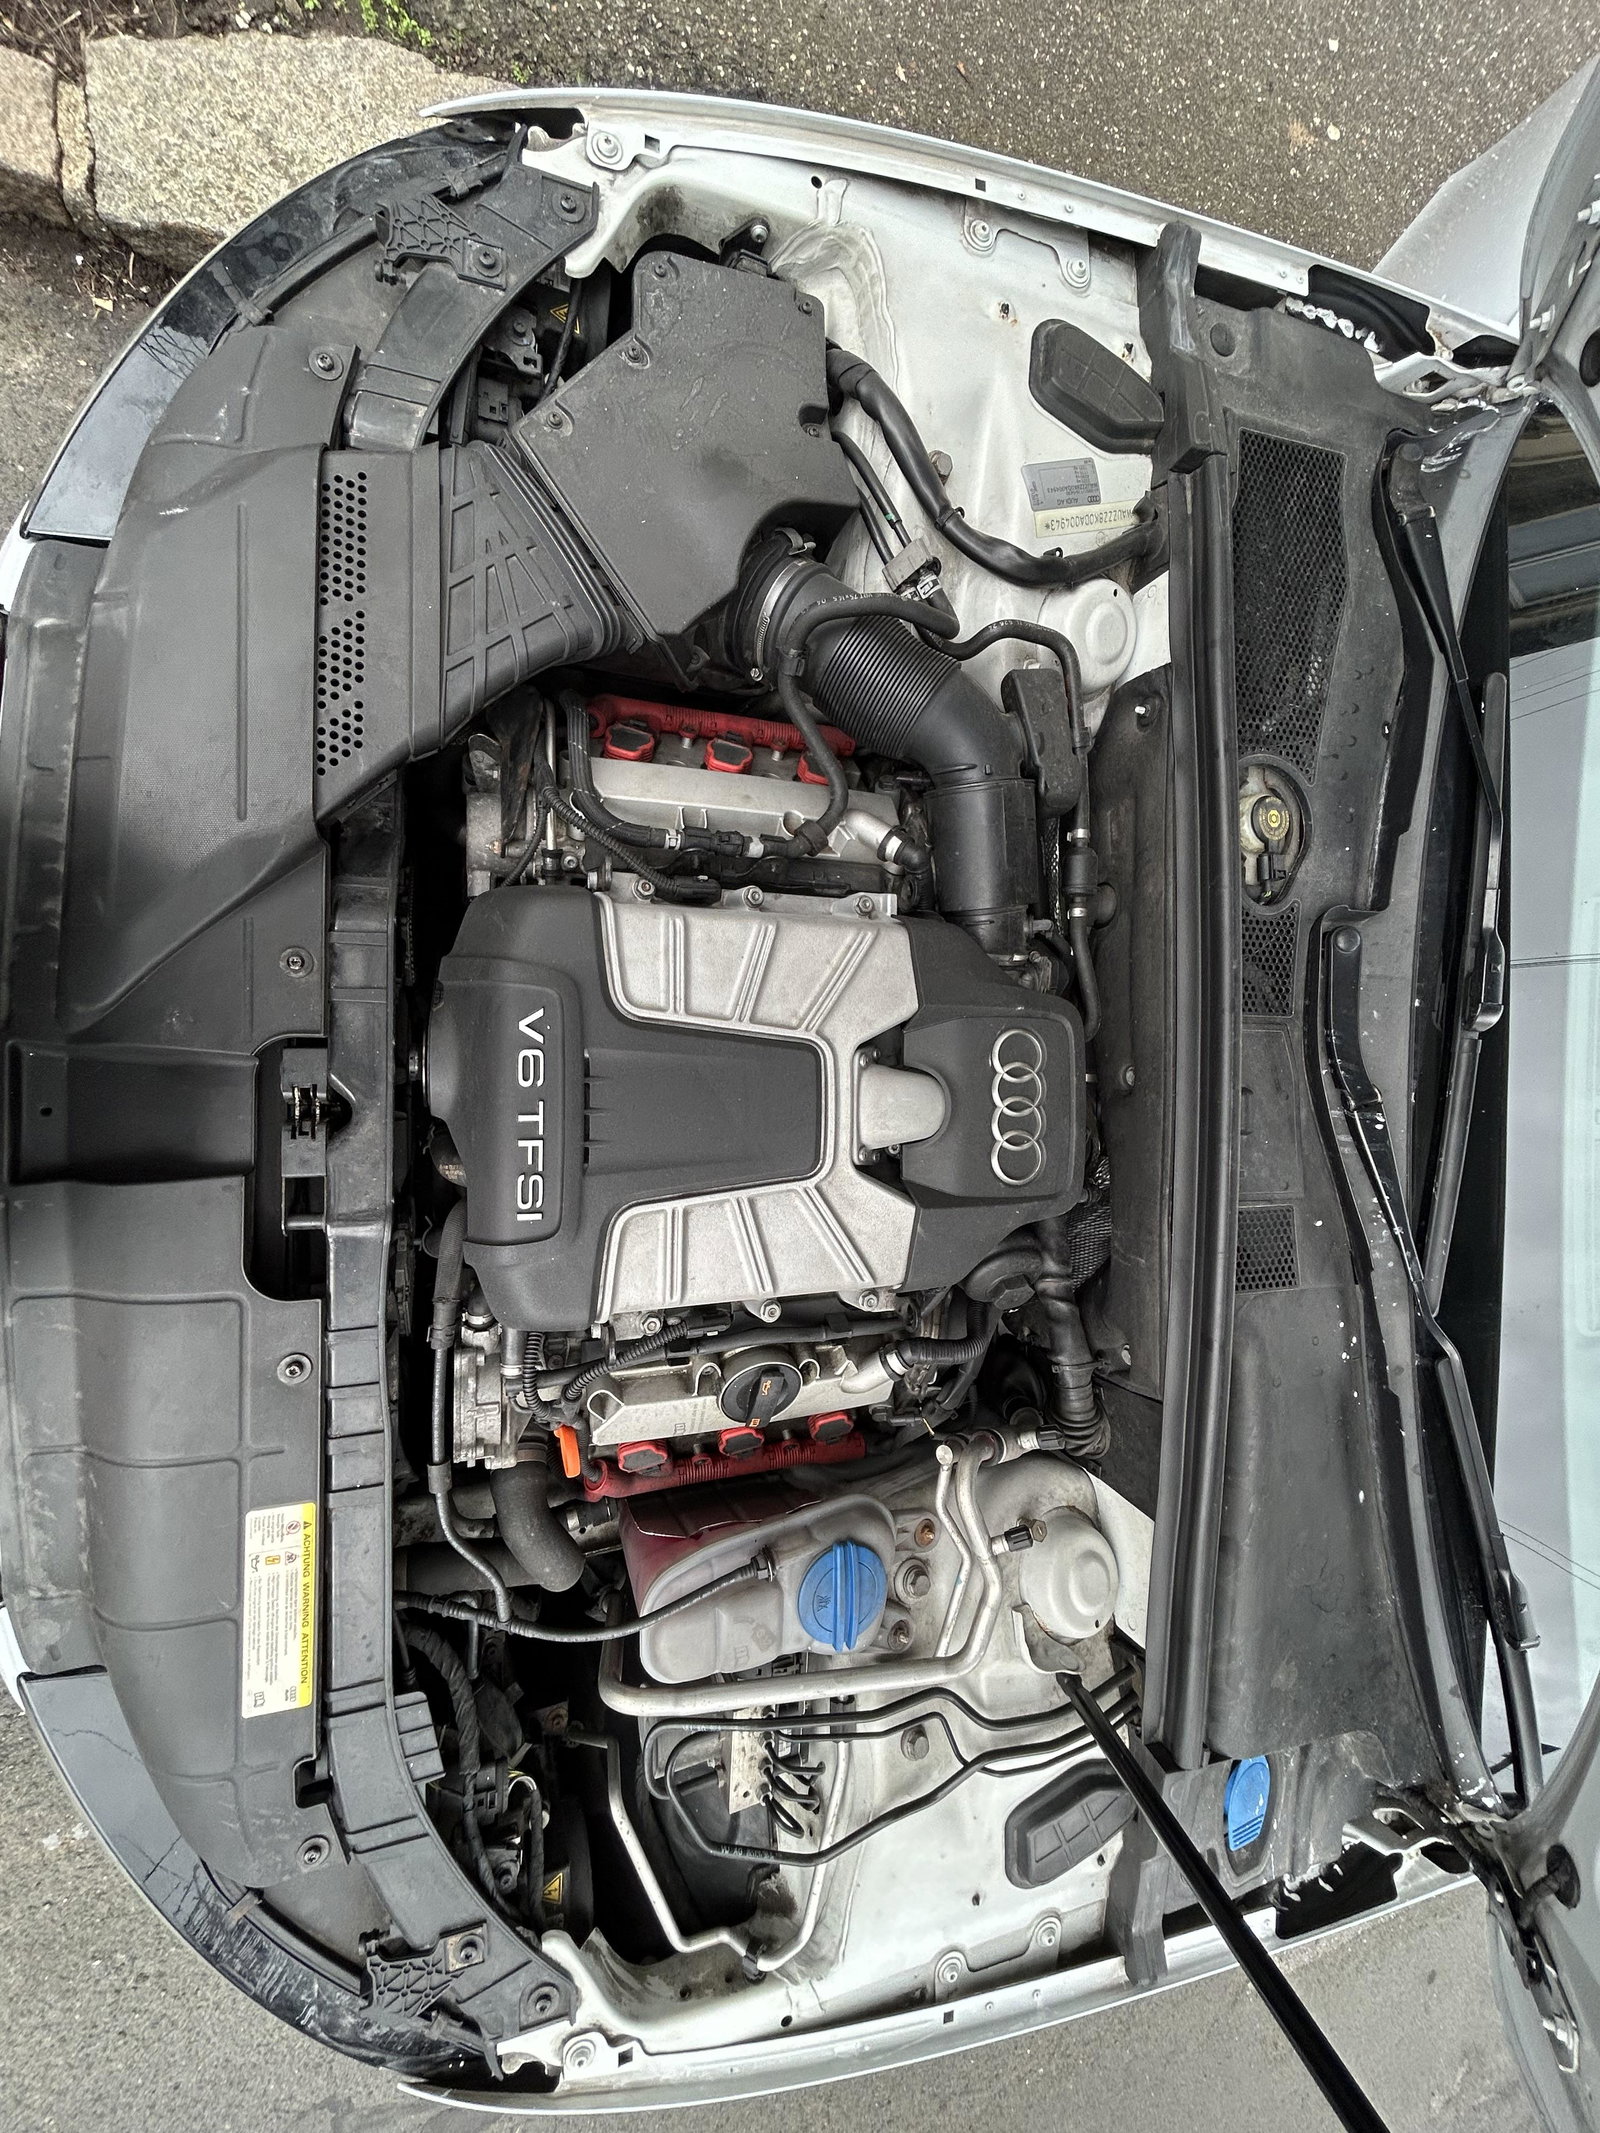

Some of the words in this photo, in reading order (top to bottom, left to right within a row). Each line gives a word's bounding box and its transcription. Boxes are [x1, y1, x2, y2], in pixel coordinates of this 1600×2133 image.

[518, 1007, 545, 1088] V6
[516, 1100, 545, 1222] TFSI
[302, 1533, 311, 1578] ACHTUNG
[301, 1581, 311, 1629] WARNING
[300, 1632, 310, 1684] ATTENTION
